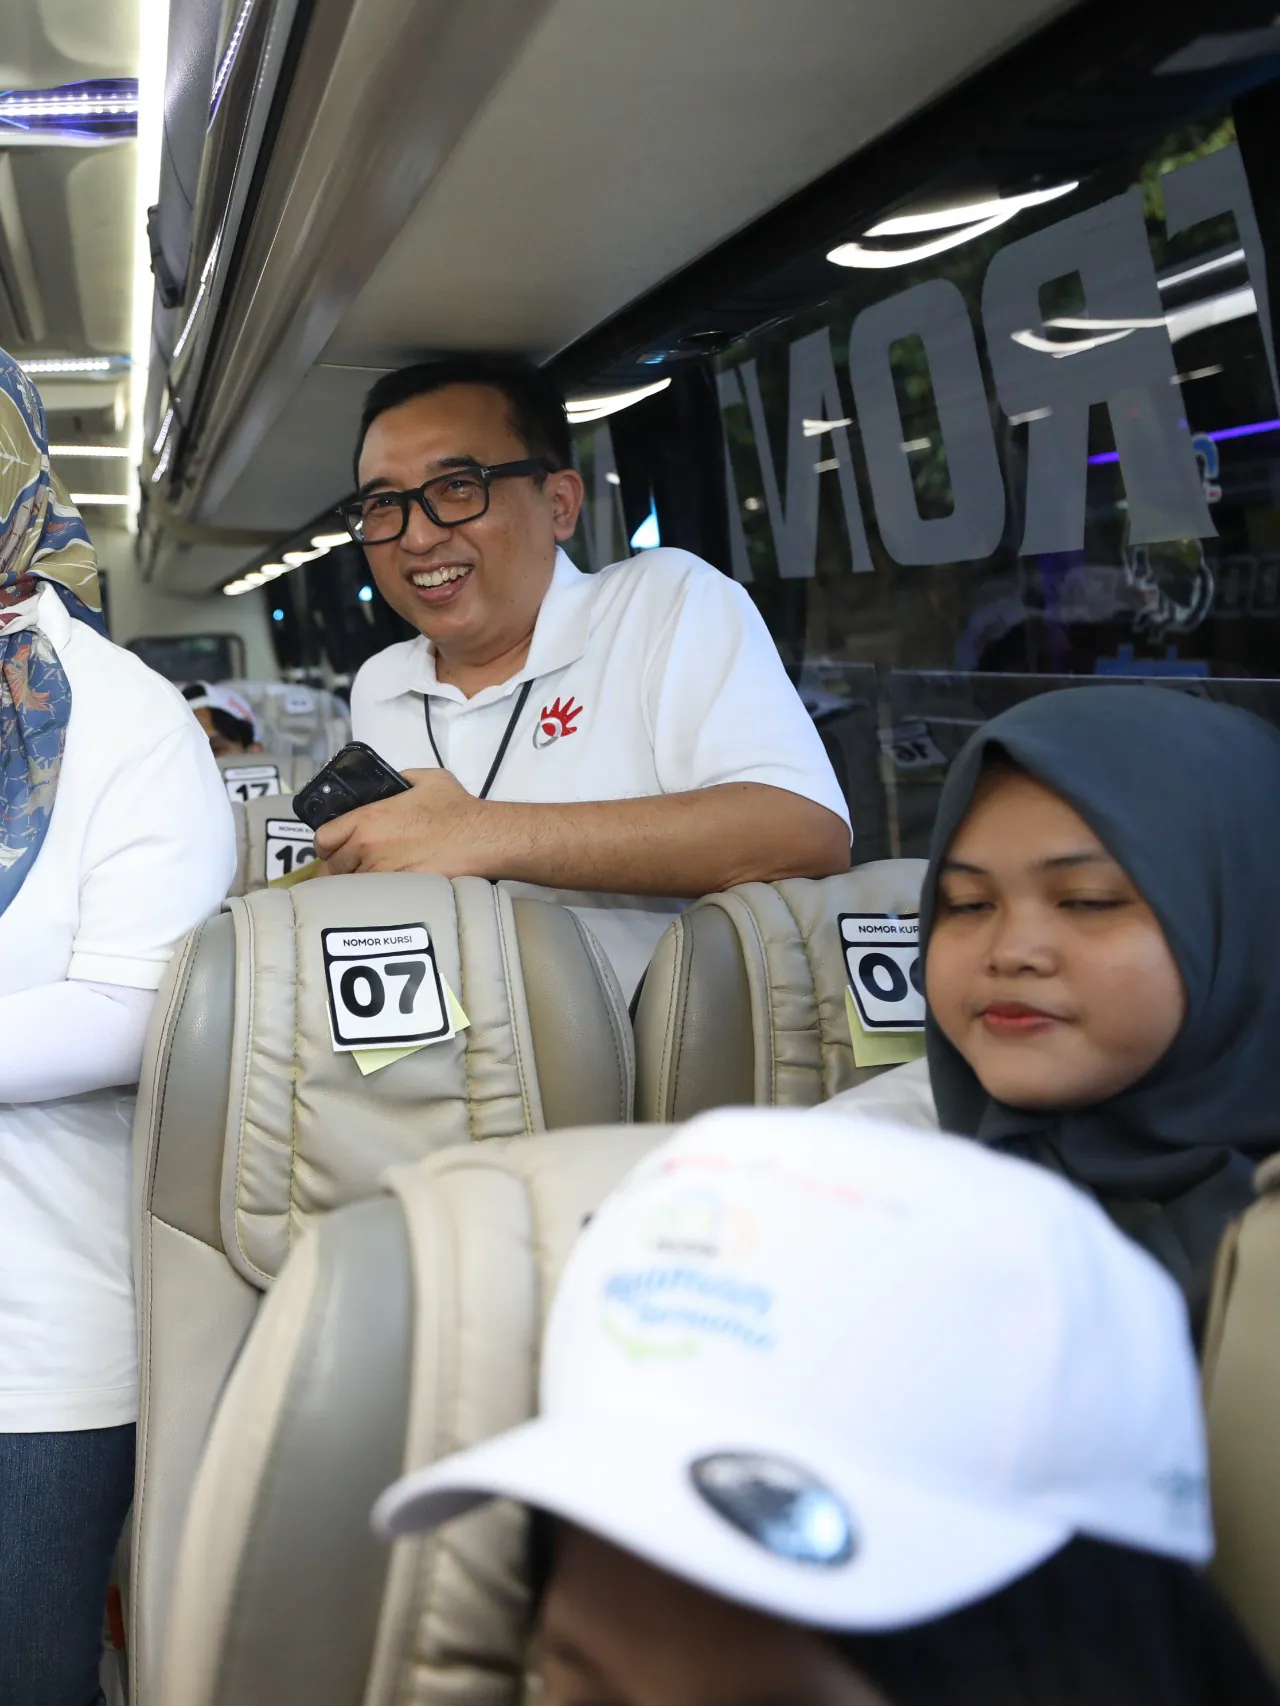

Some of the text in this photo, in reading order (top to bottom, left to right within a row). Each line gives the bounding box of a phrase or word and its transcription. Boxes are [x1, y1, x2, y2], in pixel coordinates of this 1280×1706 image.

[858, 925, 919, 934] NOMOR KUR
[343, 935, 413, 947] NOMOR KURSI
[340, 960, 427, 1018] 07
